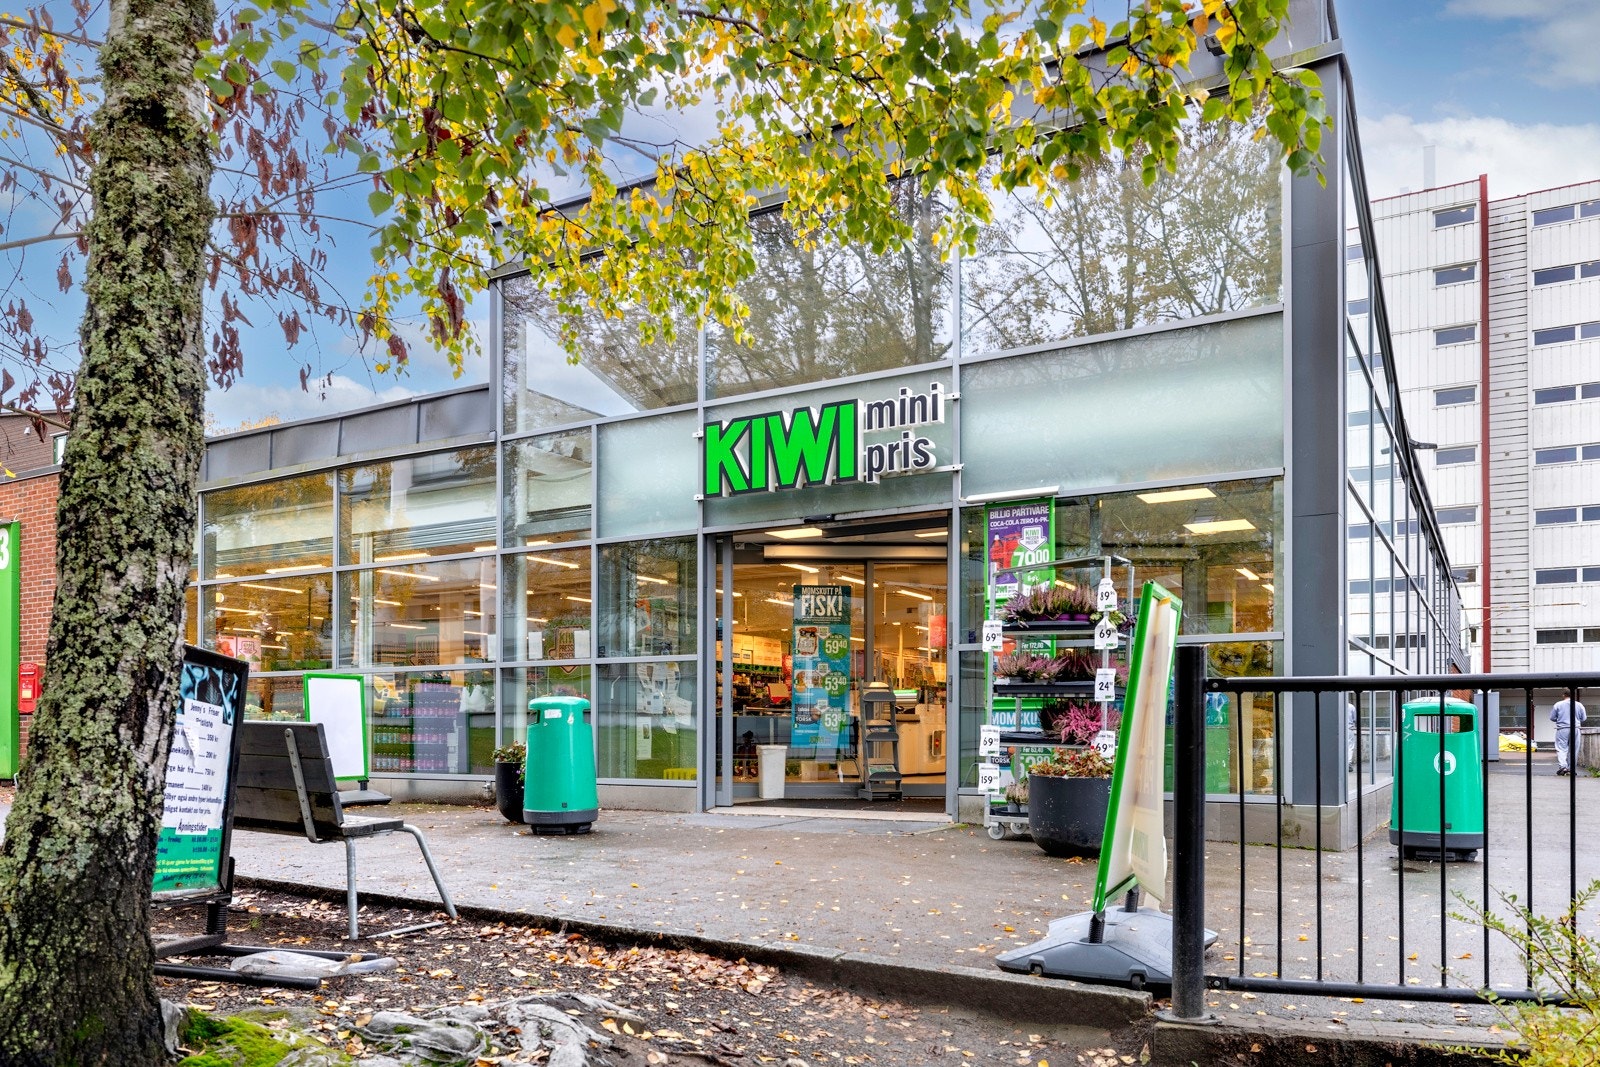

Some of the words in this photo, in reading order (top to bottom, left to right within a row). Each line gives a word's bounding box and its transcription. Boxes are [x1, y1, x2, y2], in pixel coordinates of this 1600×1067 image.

[866, 382, 944, 432] mini
[703, 399, 864, 498] KIWI
[866, 431, 936, 484] pris
[989, 509, 1011, 519] BILLIG
[1011, 505, 1050, 517] PARTIVARE
[990, 519, 1020, 528] COCA-COLA
[1020, 517, 1034, 525] ZERO
[801, 587, 834, 595] MOMSKUTT
[834, 585, 843, 595] PÅ
[801, 594, 843, 617] FISK!
